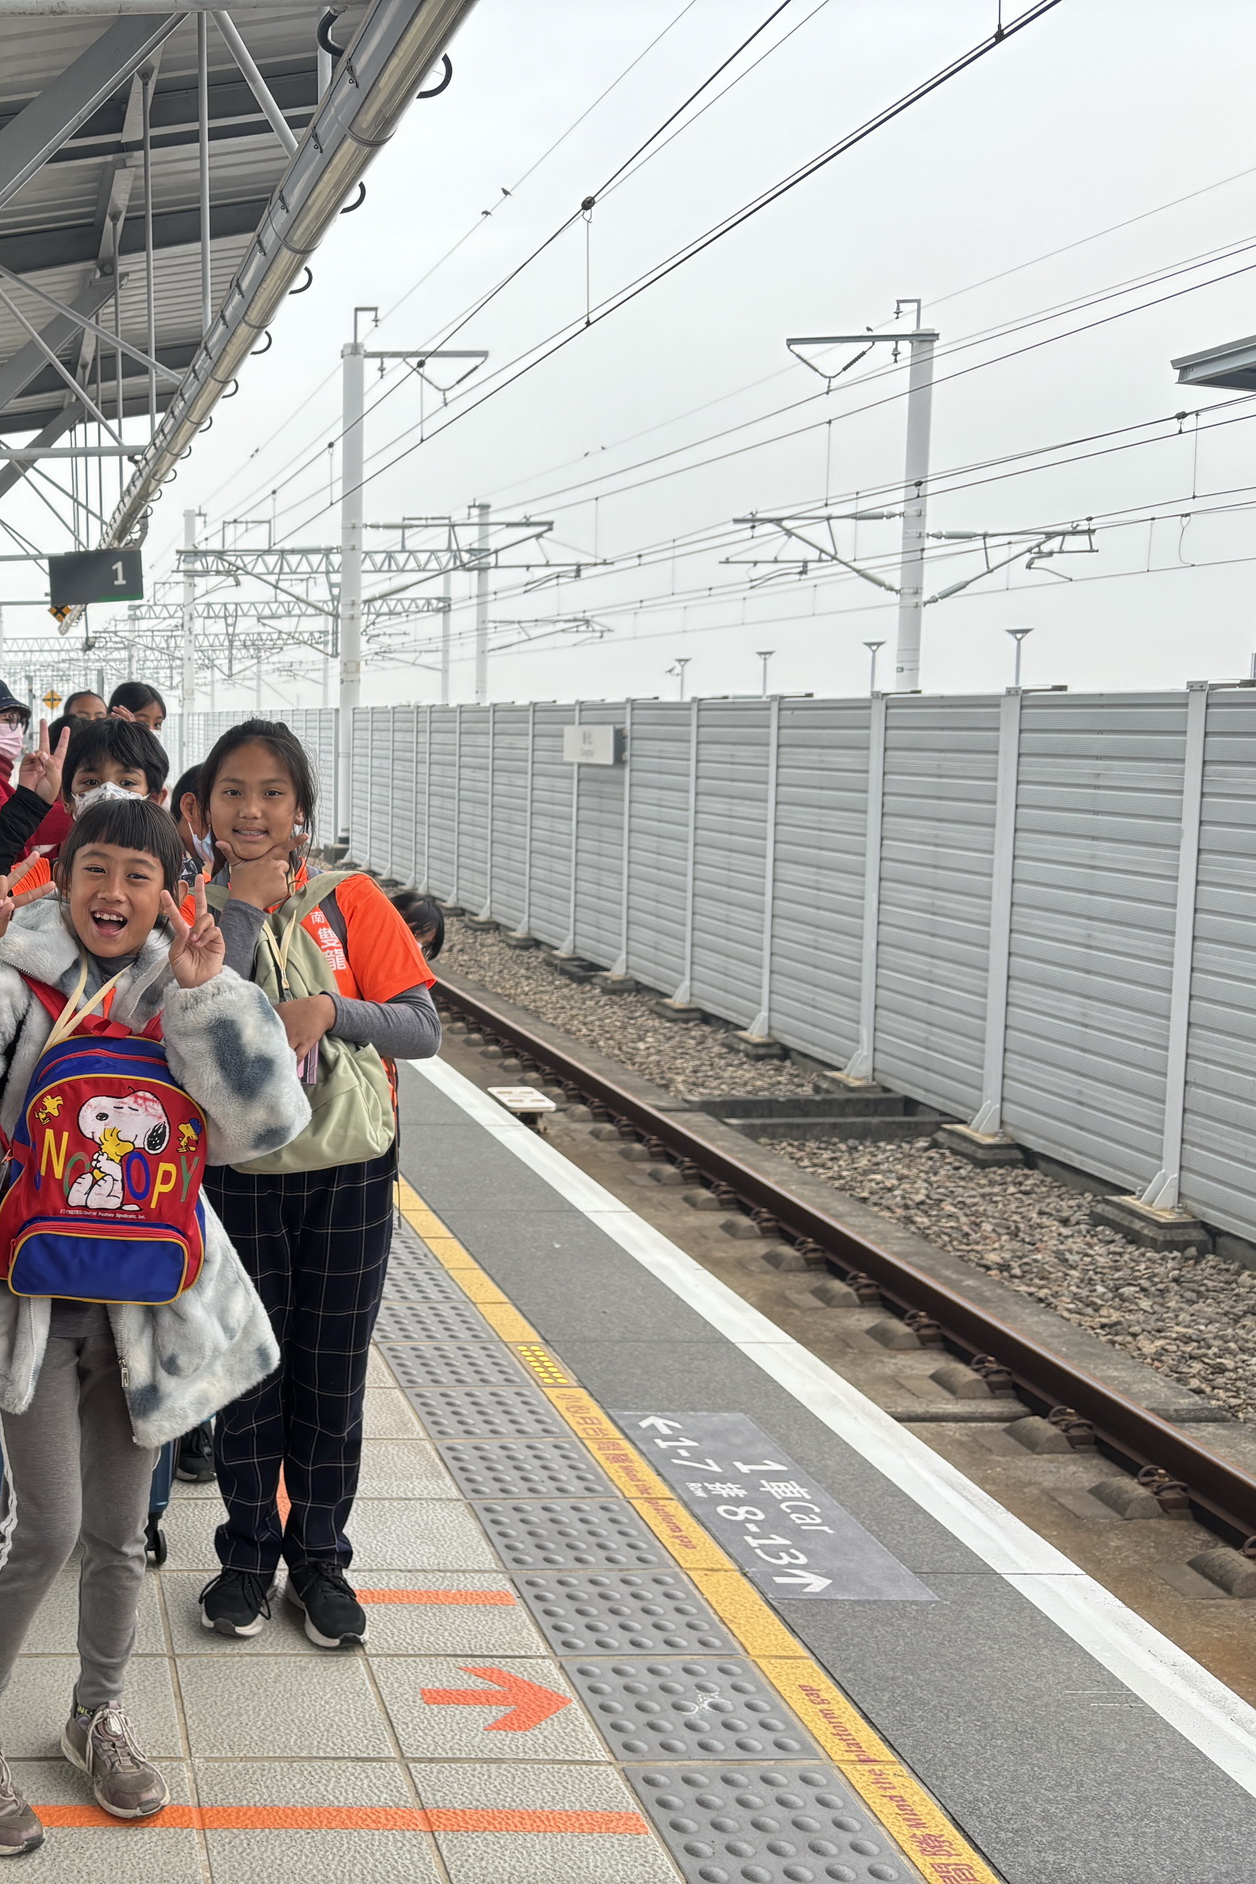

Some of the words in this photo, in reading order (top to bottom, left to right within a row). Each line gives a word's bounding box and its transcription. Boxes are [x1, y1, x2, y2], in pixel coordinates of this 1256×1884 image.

[111, 561, 126, 585] 1
[310, 911, 325, 925] 南
[685, 1482, 708, 1498] Row
[733, 1459, 788, 1473] 1
[779, 1501, 836, 1534] Car
[645, 1499, 683, 1533] platform
[671, 1534, 697, 1549] gap
[716, 1504, 808, 1565] 8-13
[797, 1684, 831, 1706] gap
[819, 1708, 879, 1763] platform
[868, 1768, 897, 1791] the
[881, 1795, 928, 1828] Mind
